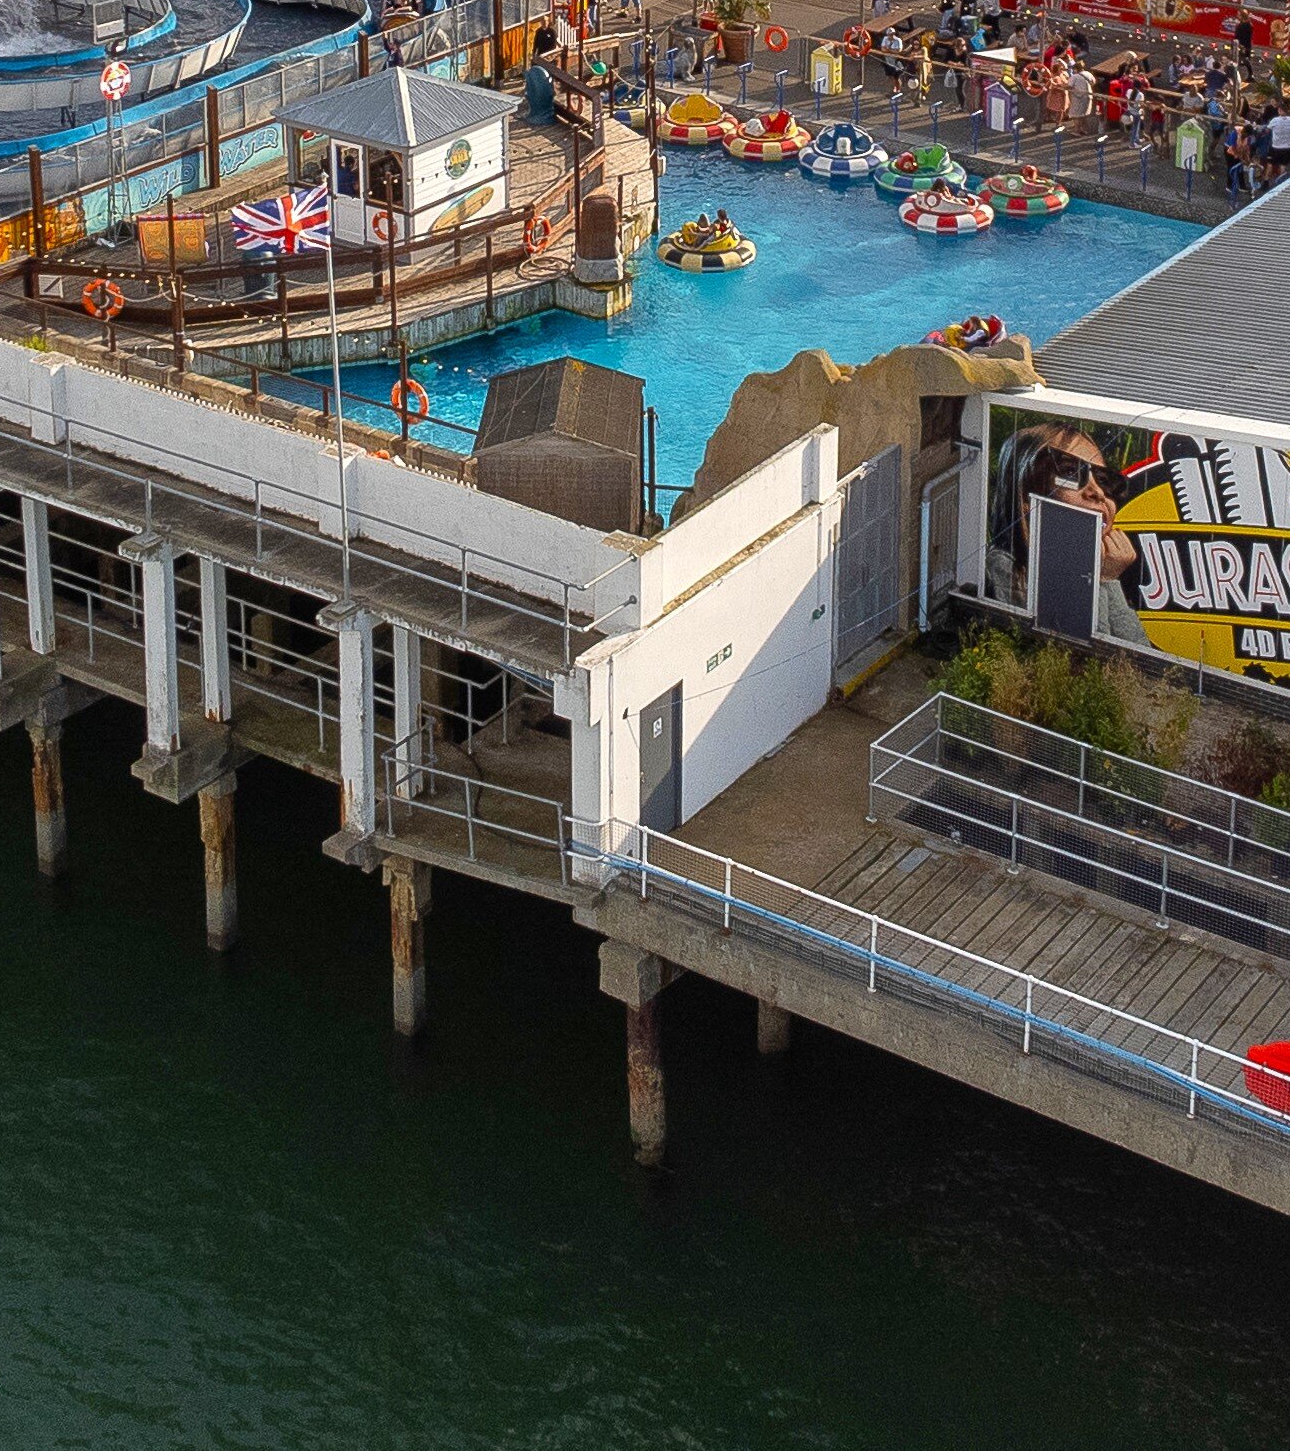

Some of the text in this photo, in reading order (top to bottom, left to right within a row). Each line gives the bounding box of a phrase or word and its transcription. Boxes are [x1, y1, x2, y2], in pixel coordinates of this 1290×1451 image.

[138, 126, 279, 208] WILD WATER
[1240, 628, 1275, 658] 4D
